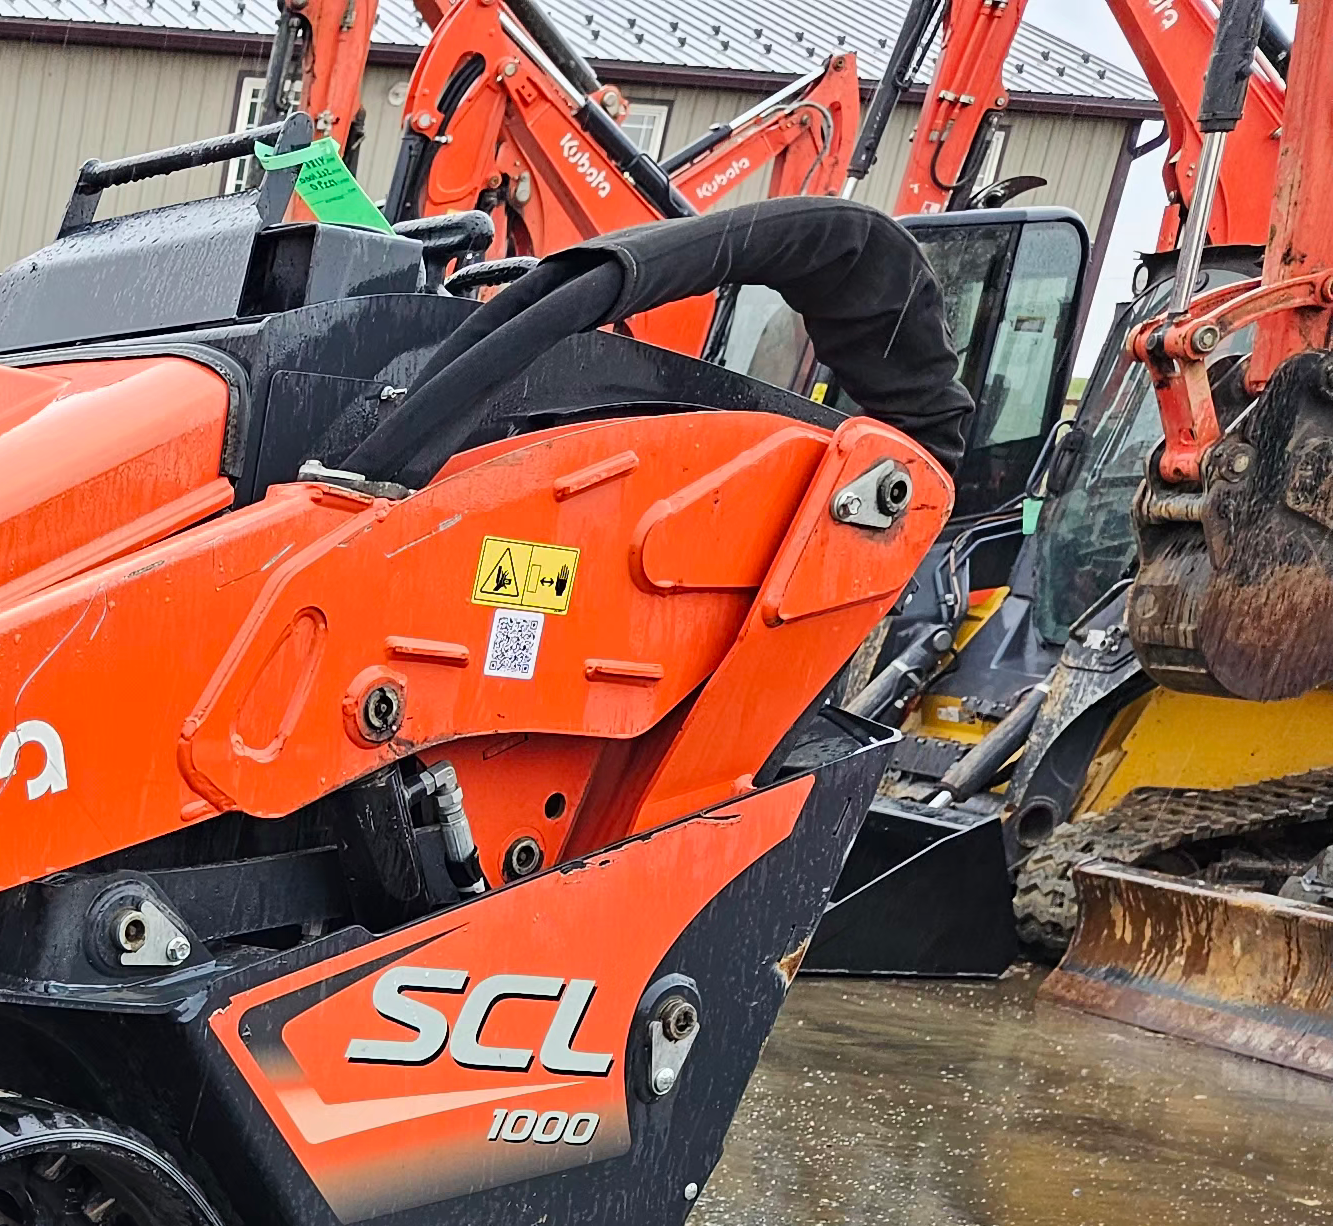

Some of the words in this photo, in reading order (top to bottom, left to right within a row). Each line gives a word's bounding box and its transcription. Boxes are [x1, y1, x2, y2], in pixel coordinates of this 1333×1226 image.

[559, 132, 612, 199] Kubota
[694, 157, 751, 200] Kubota
[343, 965, 615, 1078] SCL
[487, 1108, 602, 1146] 1000
